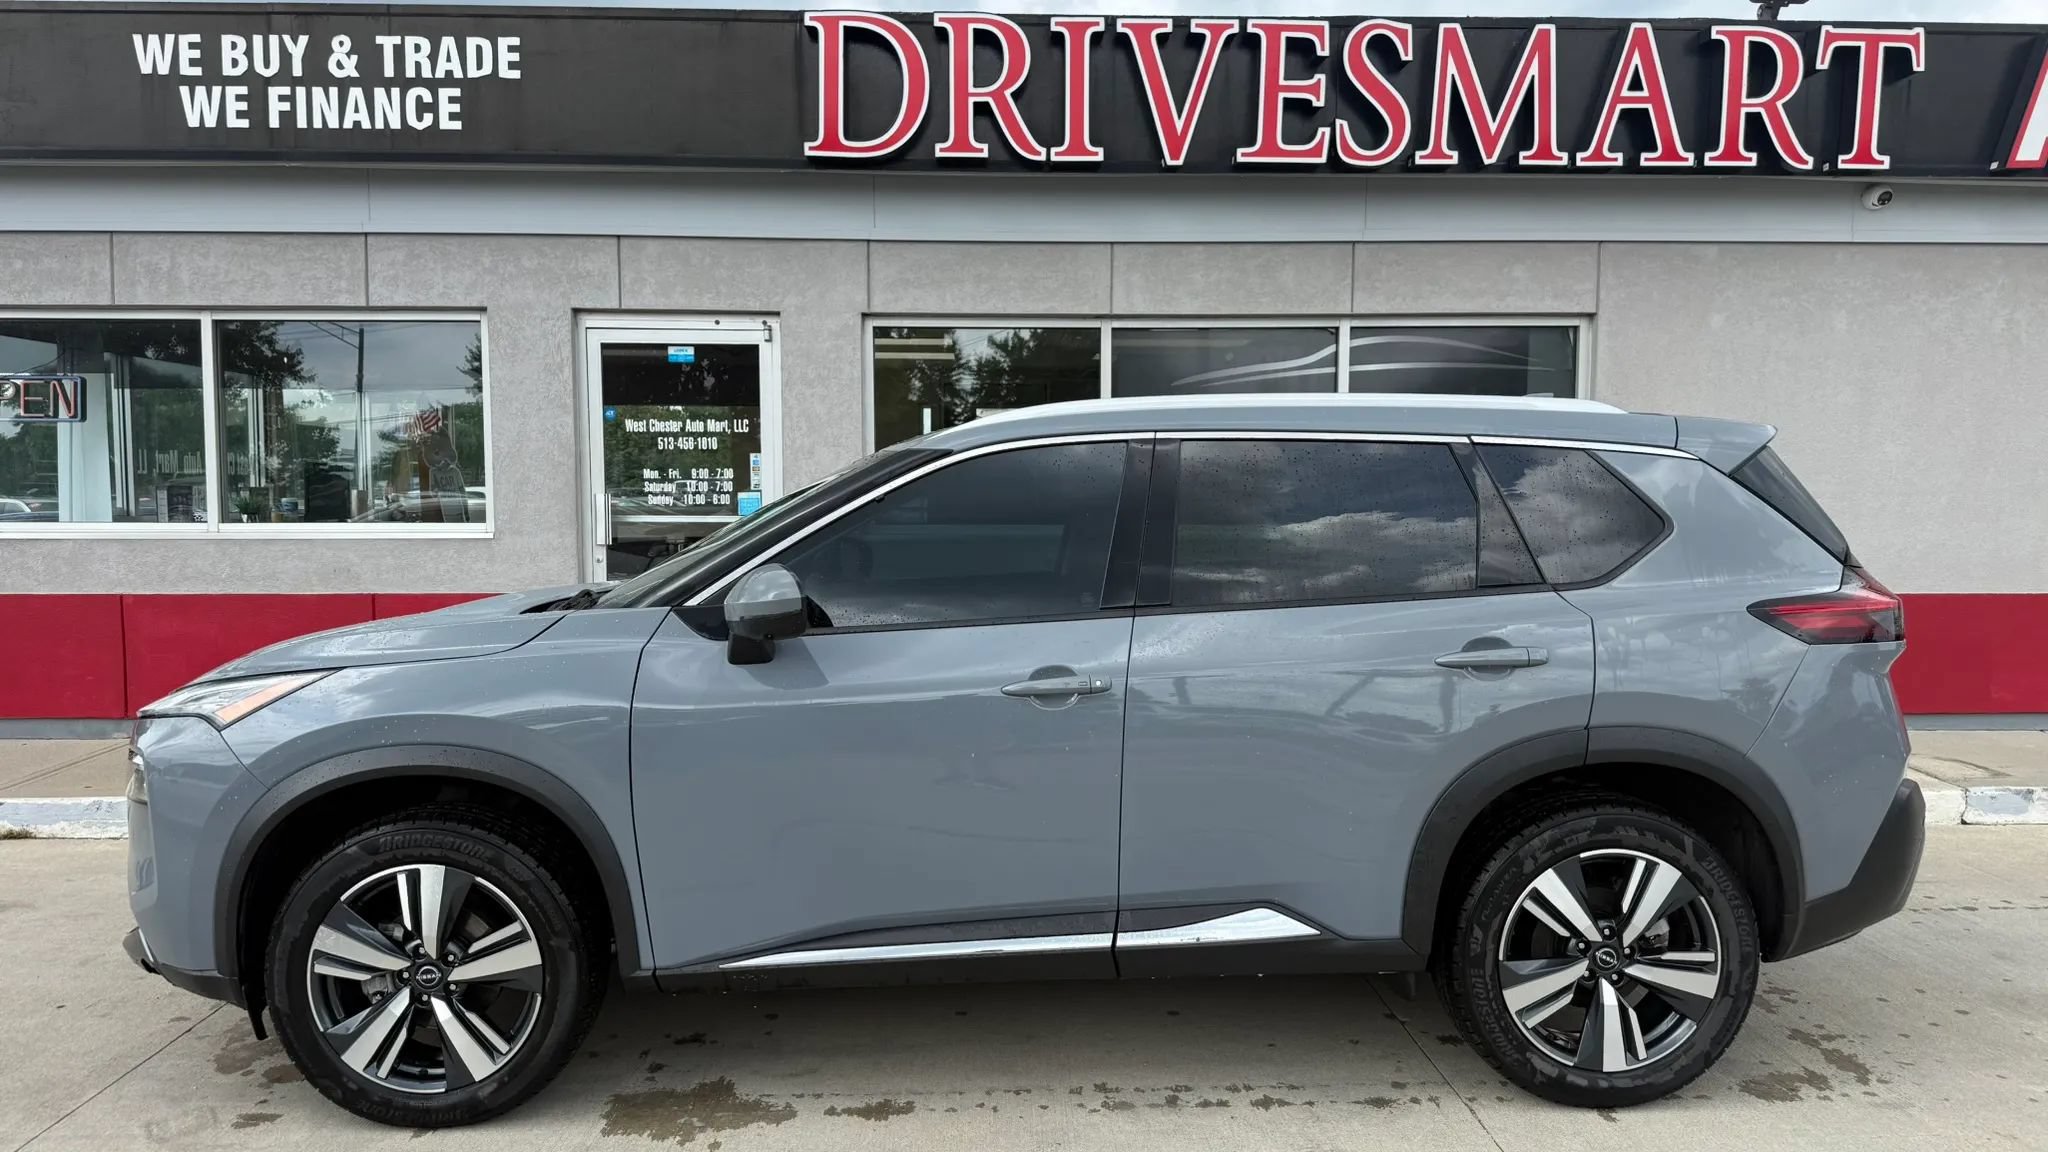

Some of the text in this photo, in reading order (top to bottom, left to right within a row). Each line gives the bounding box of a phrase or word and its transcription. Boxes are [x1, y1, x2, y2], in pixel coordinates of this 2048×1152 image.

[133, 33, 522, 80] WE BUY & TRADE
[804, 10, 1926, 171] DRIVESMART
[179, 85, 463, 131] WE FINANCE
[0, 380, 75, 417] PEN
[624, 418, 750, 435] West Chester Auto Mart, LLC
[643, 468, 661, 479] Mon.
[668, 468, 682, 479] Fri.
[691, 468, 709, 479] 9:00
[716, 468, 734, 479] 7:00
[644, 481, 676, 493] Saturday
[687, 481, 709, 492] 10:00
[715, 481, 734, 492] 7:00
[684, 494, 706, 505] 10:00
[713, 494, 731, 505] 6:00
